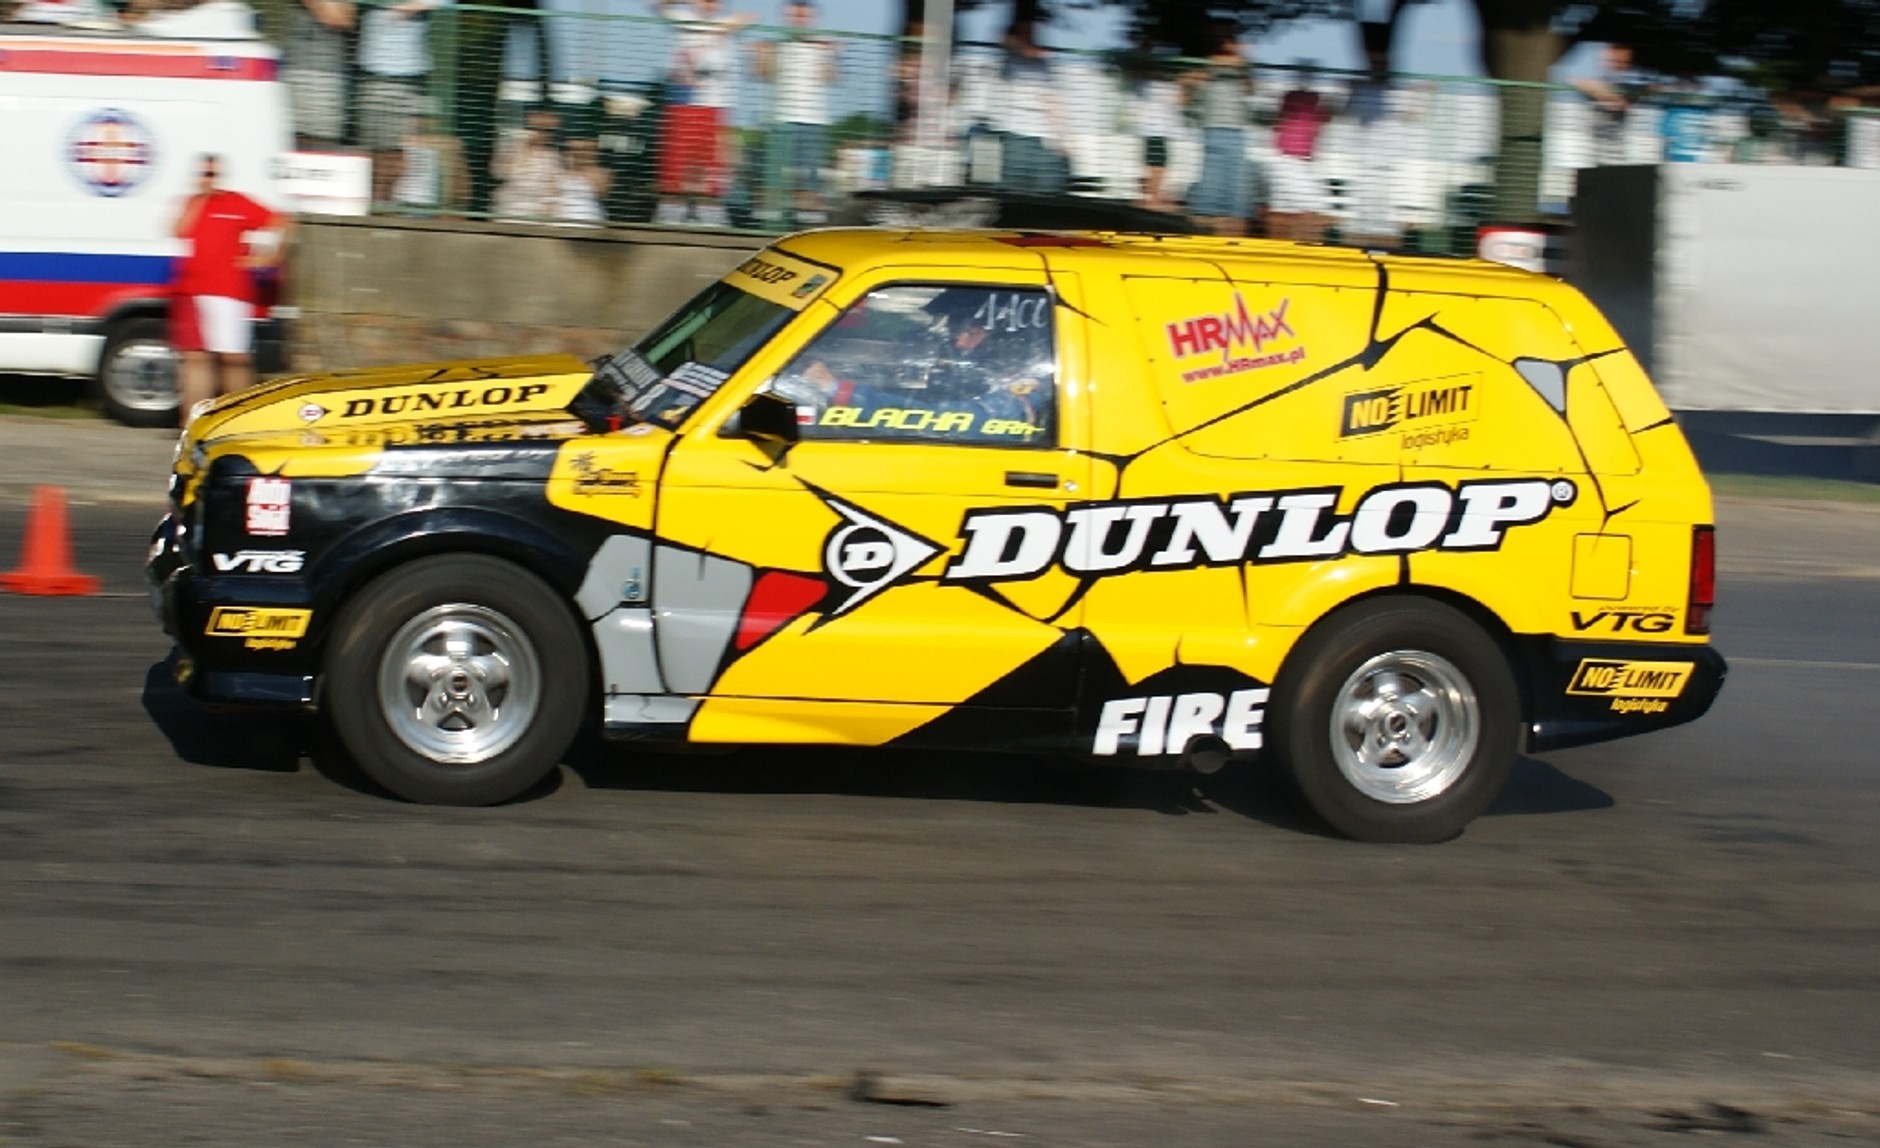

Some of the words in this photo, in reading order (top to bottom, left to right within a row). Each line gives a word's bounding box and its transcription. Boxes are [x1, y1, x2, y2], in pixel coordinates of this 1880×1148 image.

[341, 384, 549, 418] DUNLOP
[1349, 396, 1389, 429] NO
[1405, 385, 1472, 419] LIMIT
[819, 406, 975, 432] BLACHA
[945, 481, 1550, 578] DUNLOP
[213, 553, 306, 573] VTG
[1571, 611, 1675, 633] VTG
[1581, 666, 1617, 688] NO
[1623, 670, 1683, 690] LIMIT
[1092, 688, 1271, 755] FIRE
